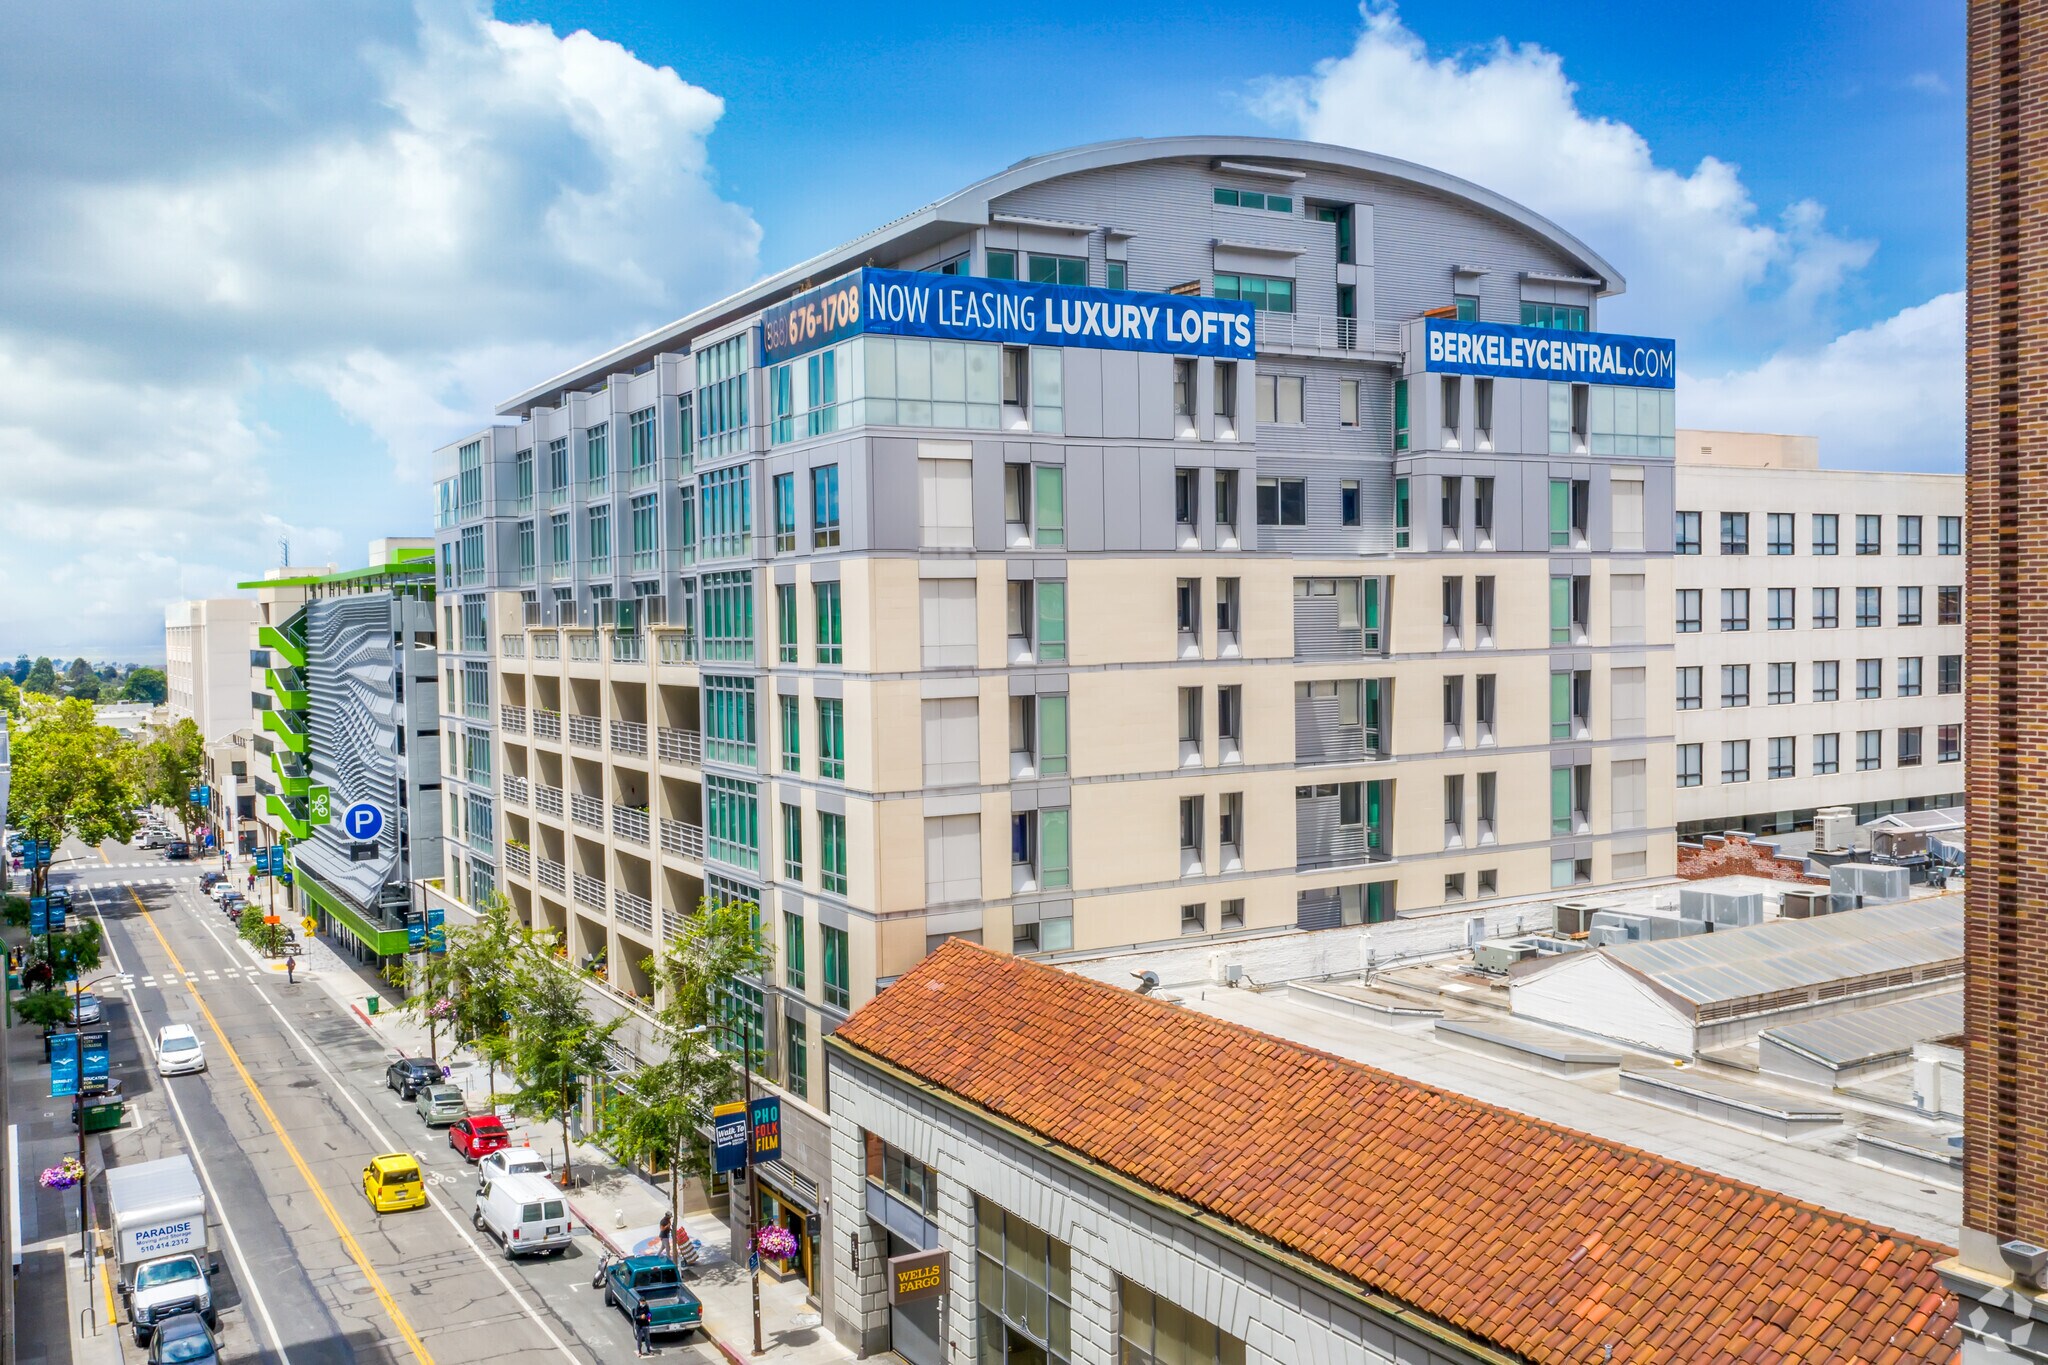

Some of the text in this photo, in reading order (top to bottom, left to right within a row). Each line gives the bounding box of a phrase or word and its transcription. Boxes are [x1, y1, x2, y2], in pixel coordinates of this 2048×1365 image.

[789, 285, 859, 345] 676-1708
[869, 283, 1251, 347] NOW LEASING LUXURY LOFTS
[1430, 330, 1673, 378] BERKELEYCENTRAL.COM
[355, 810, 374, 833] P
[754, 1106, 778, 1126] PHO
[718, 1125, 745, 1138] Walk To
[755, 1121, 778, 1138] FOLK
[755, 1135, 778, 1153] FILM
[136, 1222, 191, 1240] PARADISE
[141, 1238, 189, 1253] 510.414.2312
[898, 1265, 940, 1282] WELLS
[899, 1276, 940, 1293] FARGO
